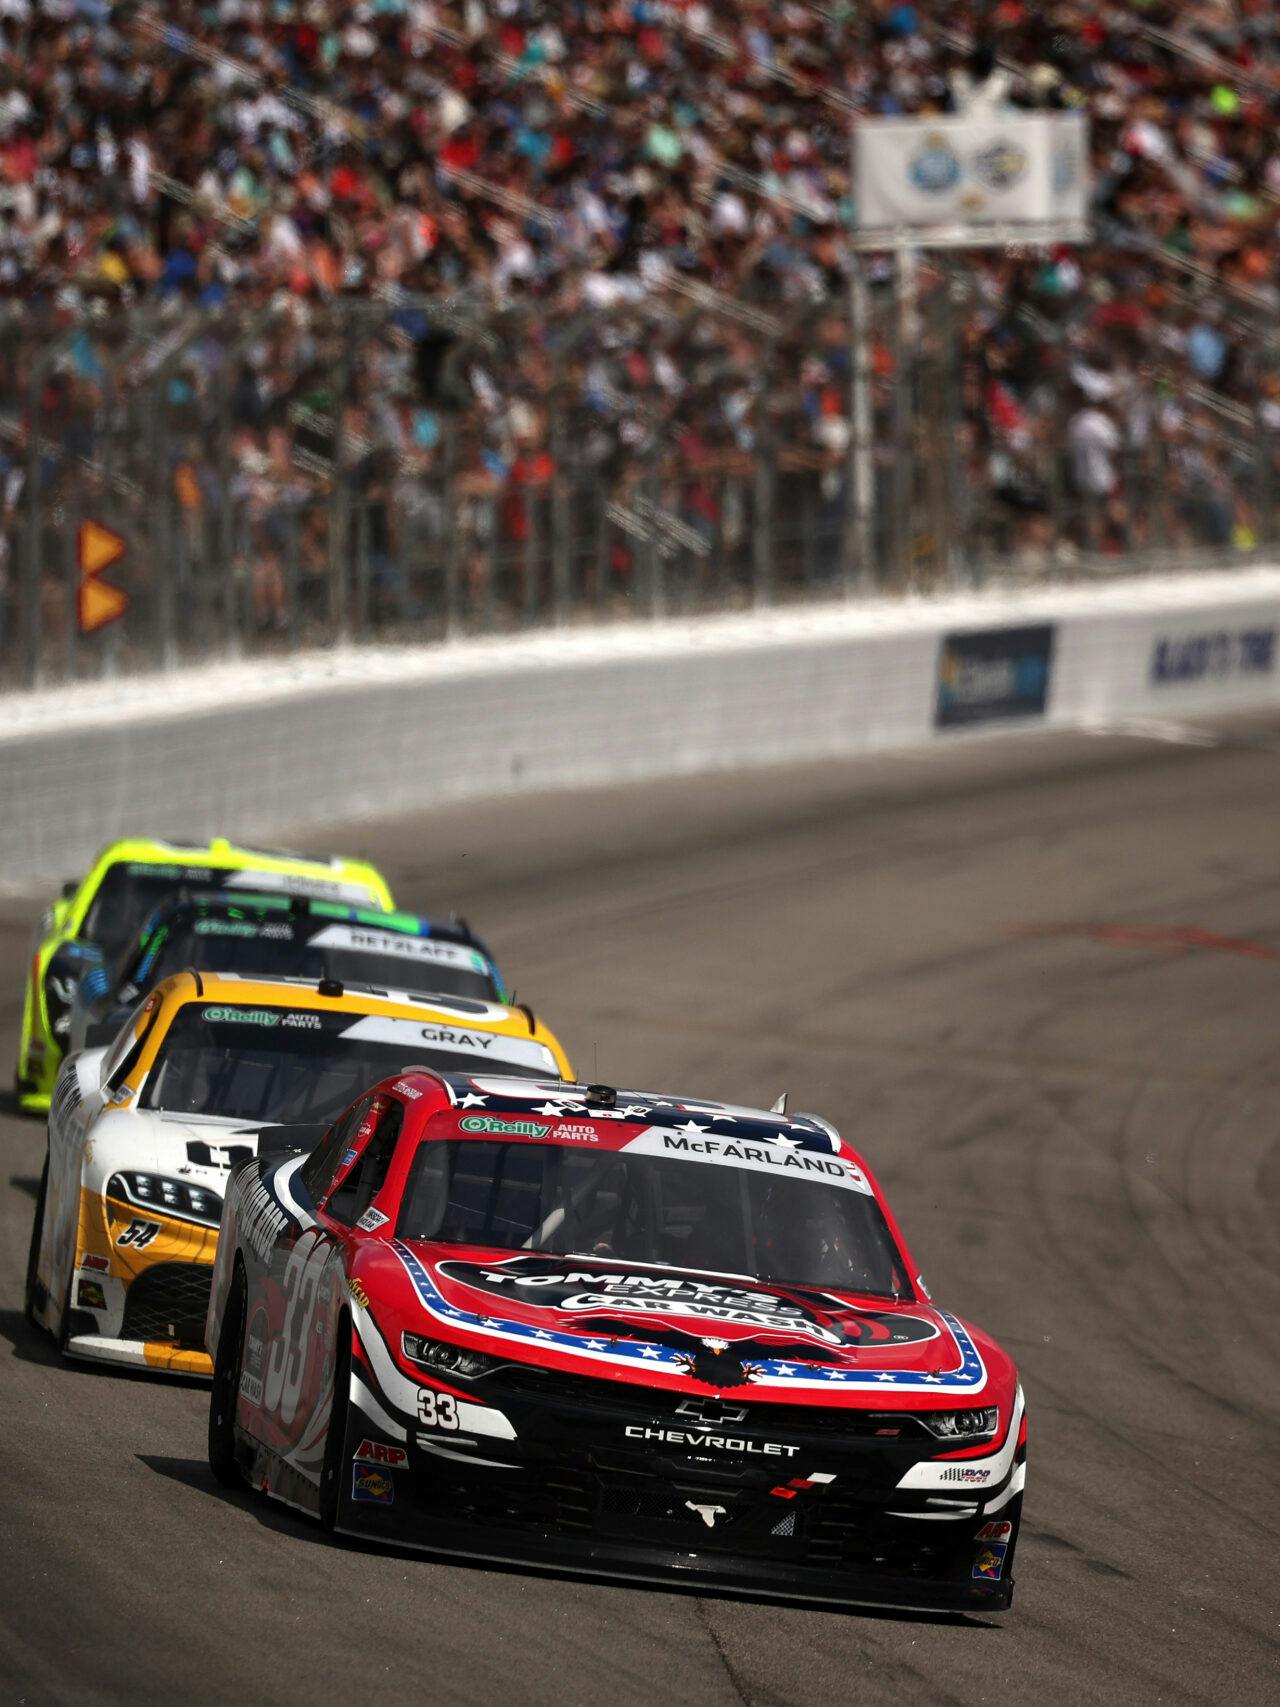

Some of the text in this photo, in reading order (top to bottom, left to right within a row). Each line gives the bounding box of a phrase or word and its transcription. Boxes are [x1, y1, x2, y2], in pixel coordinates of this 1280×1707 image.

[201, 1006, 282, 1027] O'Reilly
[282, 1020, 321, 1030] PARTS
[287, 1013, 319, 1023] AUTO
[421, 1028, 492, 1050] GRAY
[460, 1115, 552, 1139] O'Reilly
[552, 1132, 598, 1142] PARTS
[558, 1124, 595, 1134] AUTO
[663, 1135, 846, 1178] McFARLAND
[116, 1218, 161, 1250] 54
[479, 1271, 782, 1304] TOMMY'S
[603, 1284, 803, 1315] EXPRESS
[561, 1293, 826, 1338] CAR WASH
[417, 1388, 460, 1431] 33
[357, 1441, 406, 1465] ARP
[624, 1425, 801, 1458] CHEVROLET
[355, 1478, 393, 1492] SUNOCO
